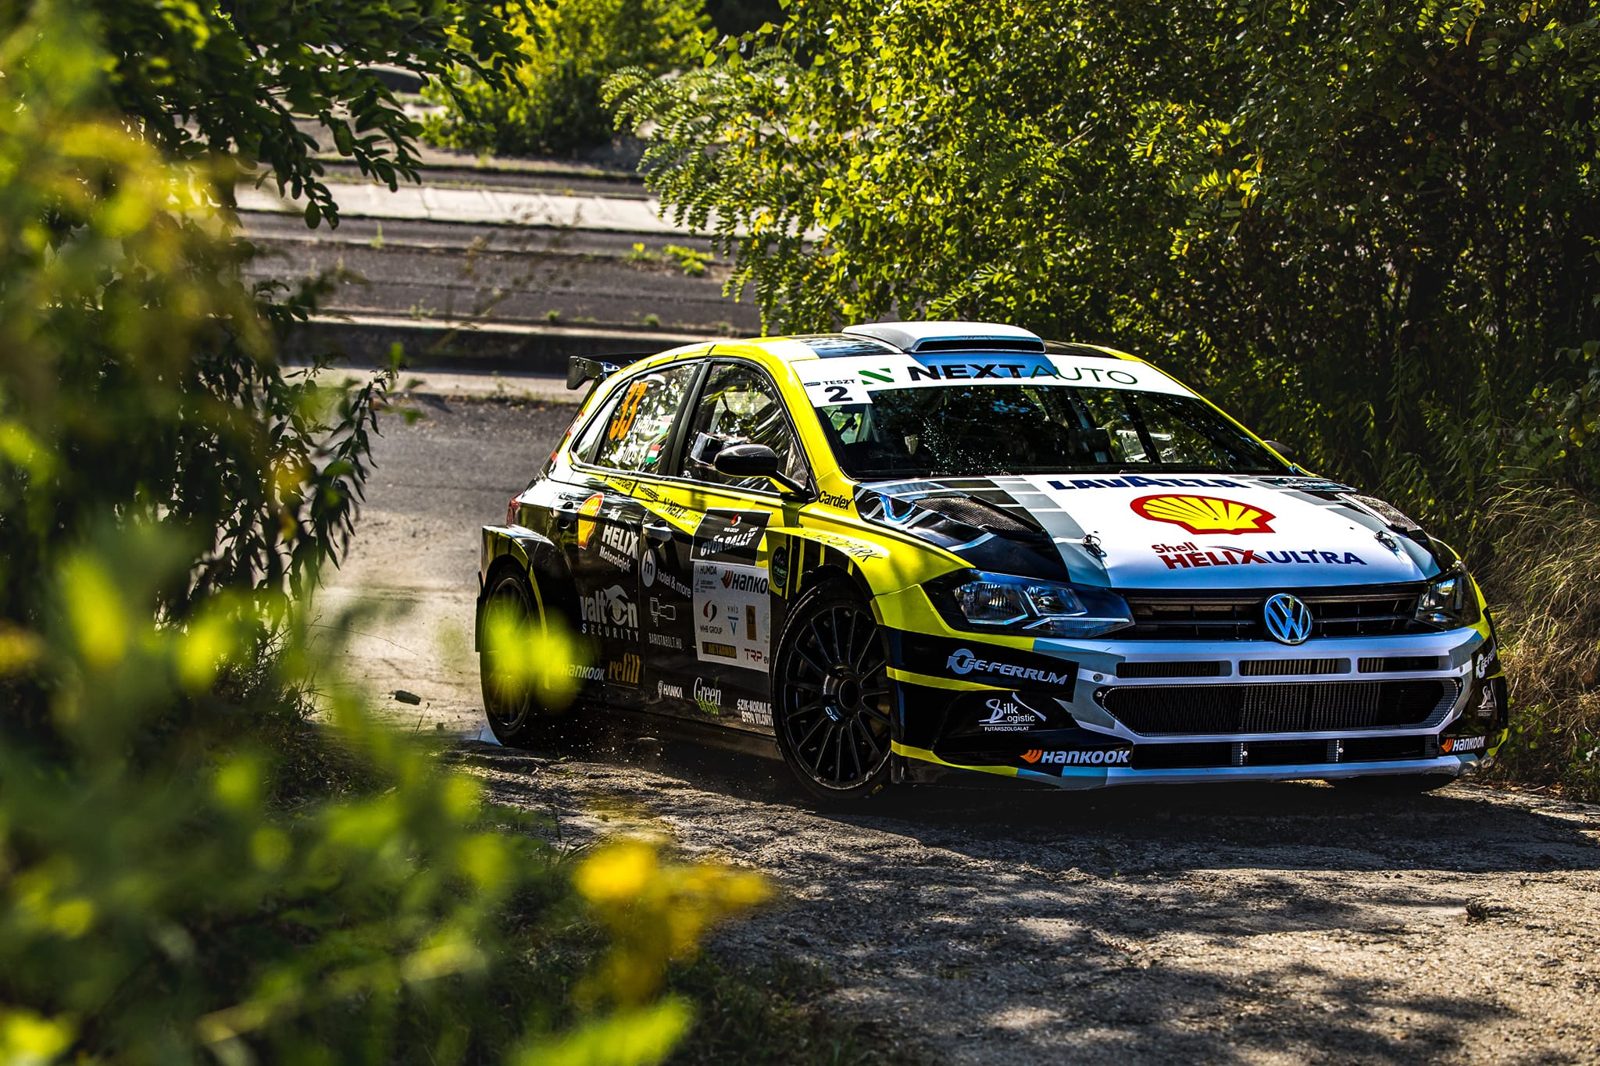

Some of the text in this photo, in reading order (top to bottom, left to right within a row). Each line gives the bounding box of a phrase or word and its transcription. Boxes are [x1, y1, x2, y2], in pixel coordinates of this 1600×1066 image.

[824, 386, 854, 403] 2
[609, 380, 648, 440] 33
[1047, 475, 1252, 490] LAVAZZA
[818, 490, 853, 510] Cardex
[601, 524, 639, 560] HELIX
[1151, 541, 1199, 554] Shell
[1158, 549, 1368, 570] HELIX ULTRA
[656, 568, 671, 586] hotel
[676, 582, 692, 598] more
[582, 623, 639, 642] SECURITY
[744, 648, 762, 662] TRP
[608, 652, 641, 684] refill
[693, 677, 721, 706] Green
